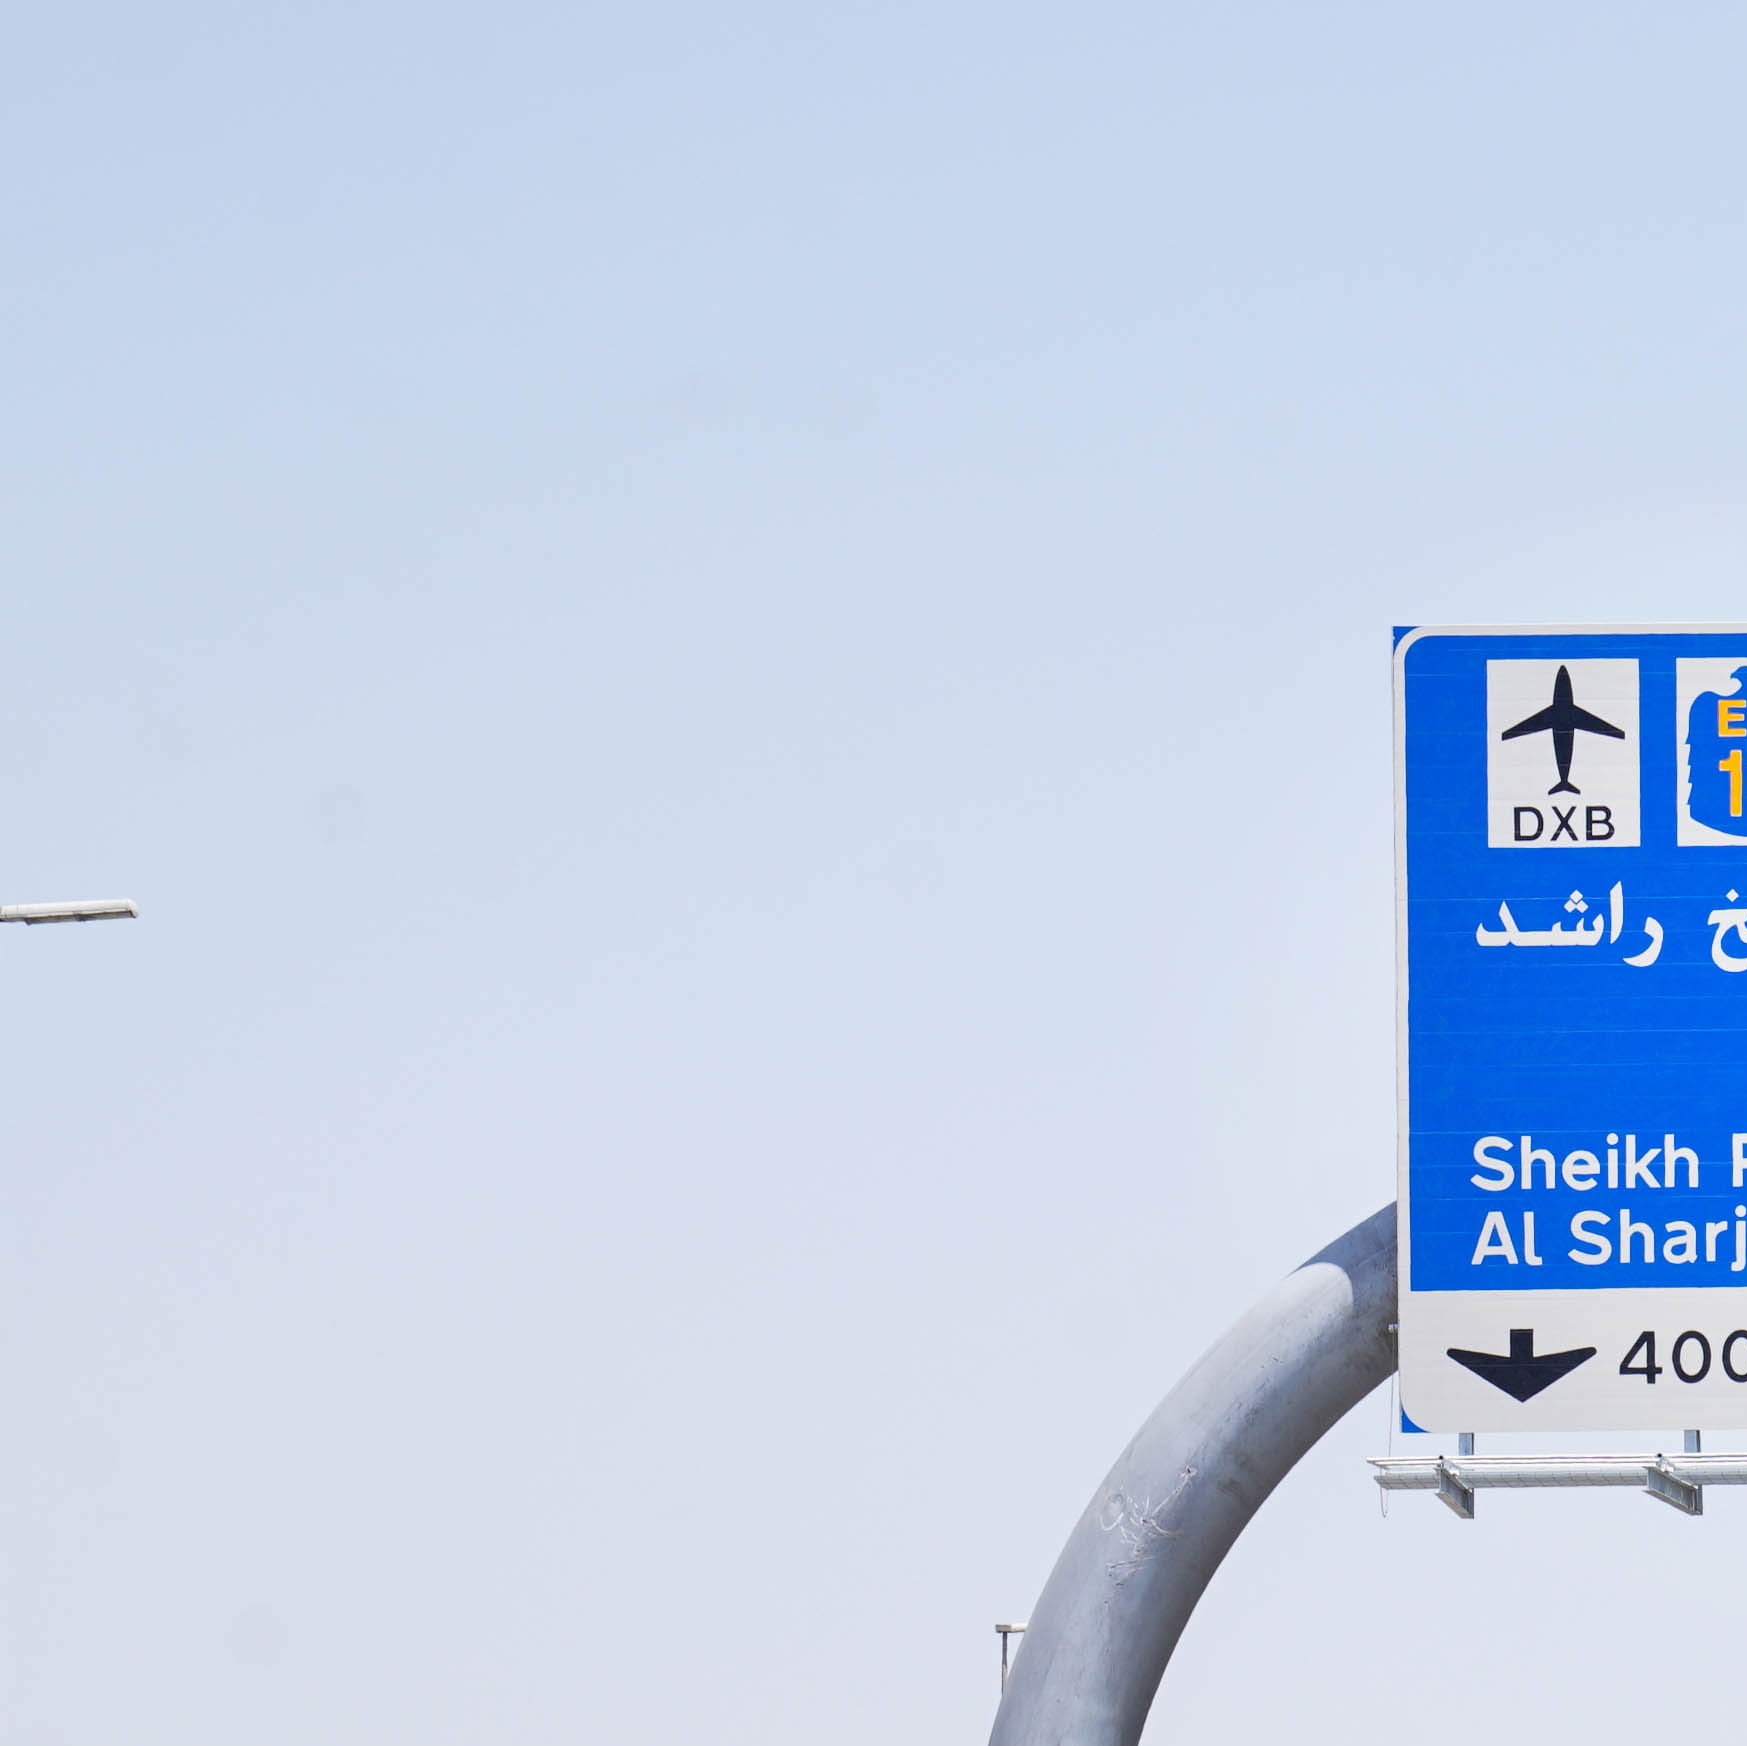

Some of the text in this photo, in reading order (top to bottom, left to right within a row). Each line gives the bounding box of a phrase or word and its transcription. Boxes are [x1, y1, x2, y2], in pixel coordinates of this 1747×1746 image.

[1718, 699, 1747, 736] E
[1514, 807, 1614, 840] DXB
[1476, 882, 1663, 967] راشد
[1471, 1133, 1698, 1191] Sheikh
[1472, 1212, 1542, 1265] Al
